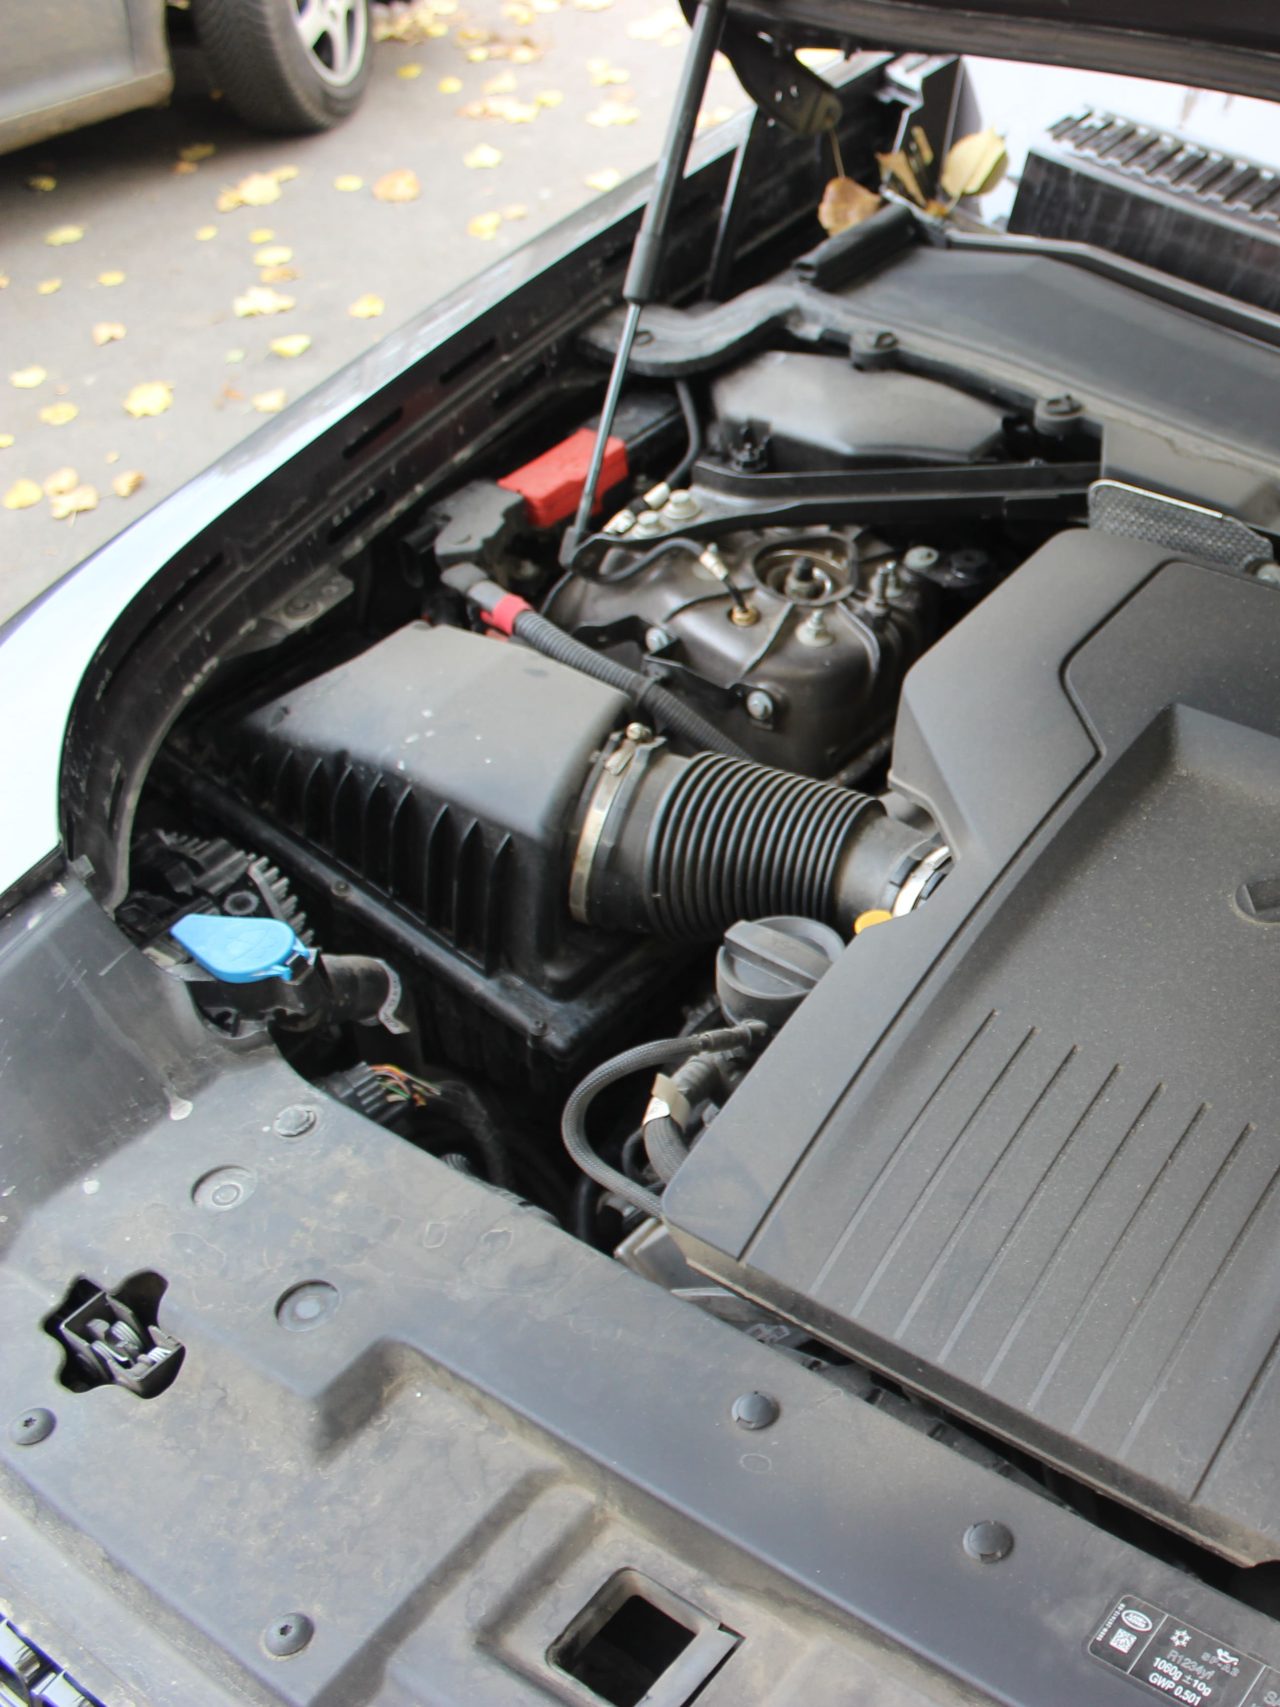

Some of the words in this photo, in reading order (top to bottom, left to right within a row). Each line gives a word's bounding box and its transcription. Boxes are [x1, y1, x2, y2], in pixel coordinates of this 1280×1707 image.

[1153, 1657, 1183, 1682] 1060g
[1167, 1649, 1215, 1680] R1234yf
[1149, 1672, 1176, 1690] GWP
[1174, 1686, 1202, 1707] 0.501
